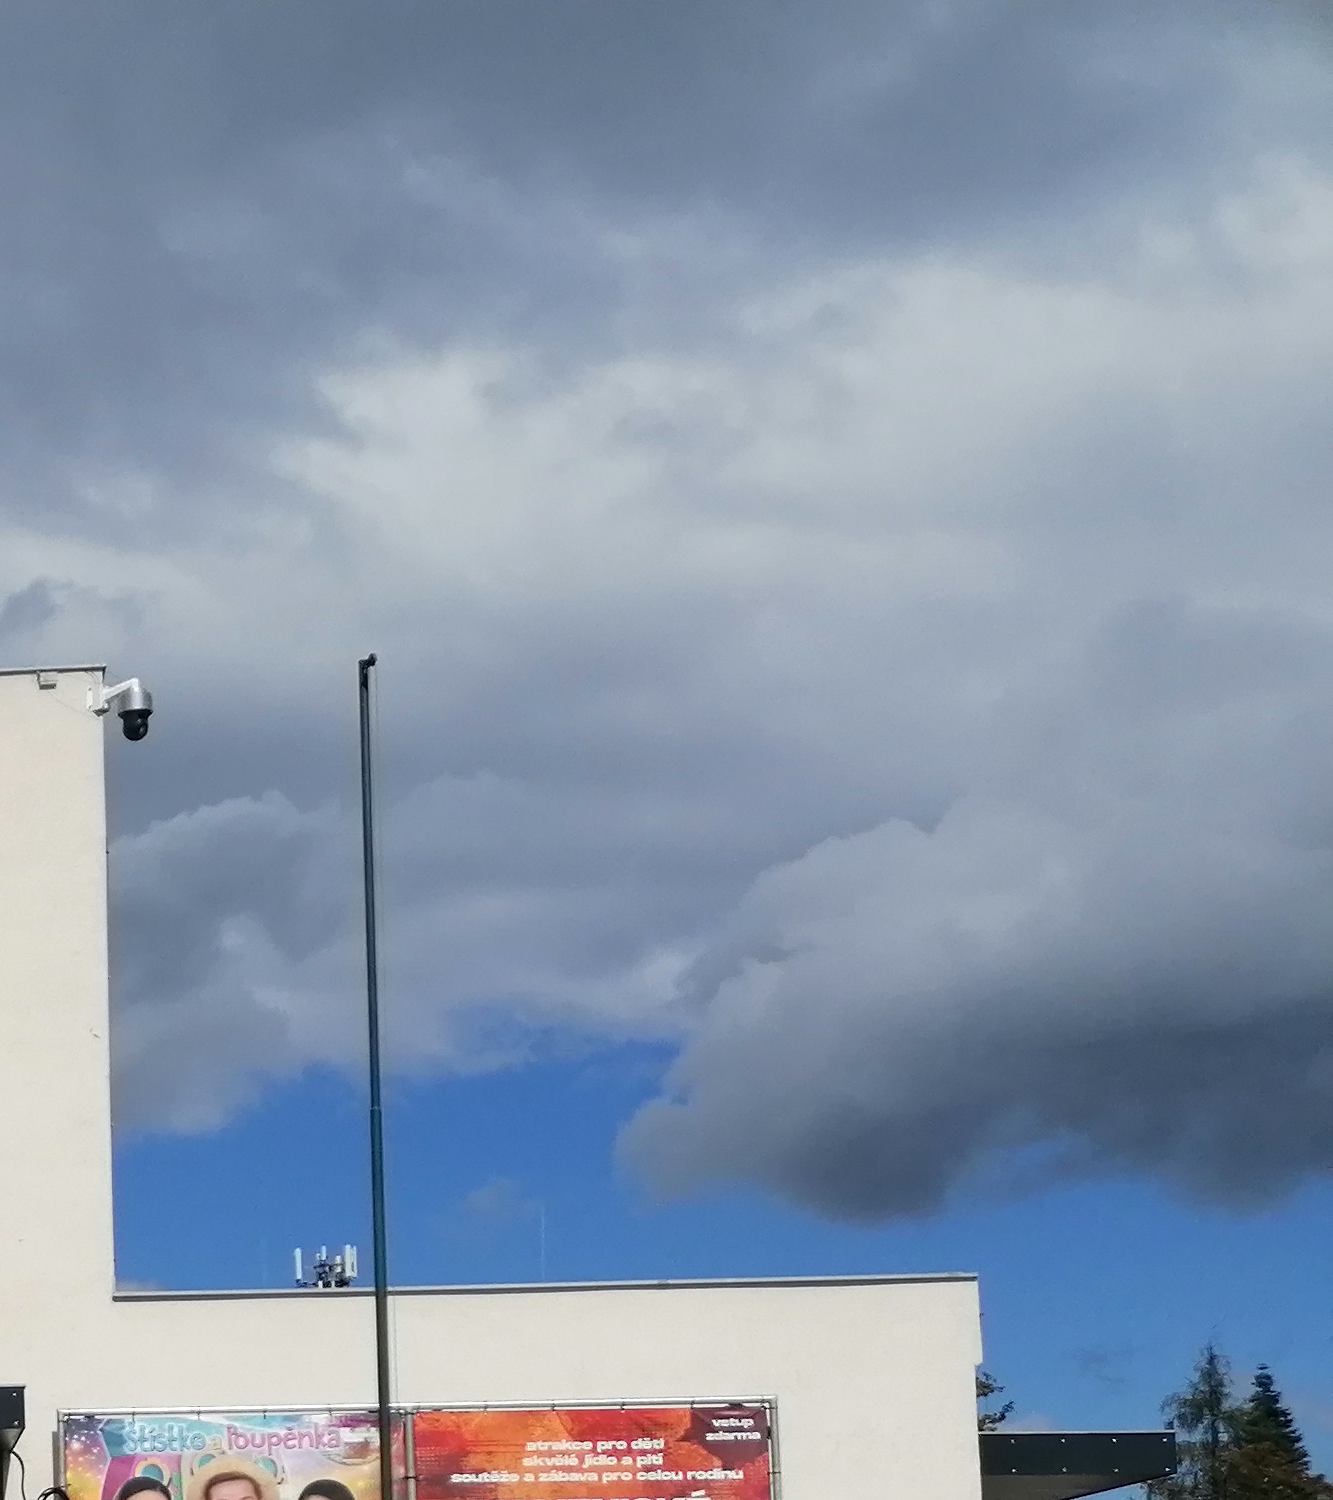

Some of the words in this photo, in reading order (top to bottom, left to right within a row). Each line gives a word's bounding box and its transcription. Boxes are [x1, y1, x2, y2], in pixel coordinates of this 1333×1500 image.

[711, 1417, 753, 1428] vstup
[227, 1422, 342, 1455] Poupěnka
[705, 1429, 761, 1441] zdarma
[525, 1439, 593, 1451] atrakce
[596, 1440, 628, 1453] pro
[522, 1453, 579, 1467] skvělé
[621, 1456, 636, 1466] a
[449, 1470, 521, 1483] soutěže
[522, 1472, 536, 1482] a
[538, 1468, 599, 1482] zábava
[602, 1472, 634, 1484] pro
